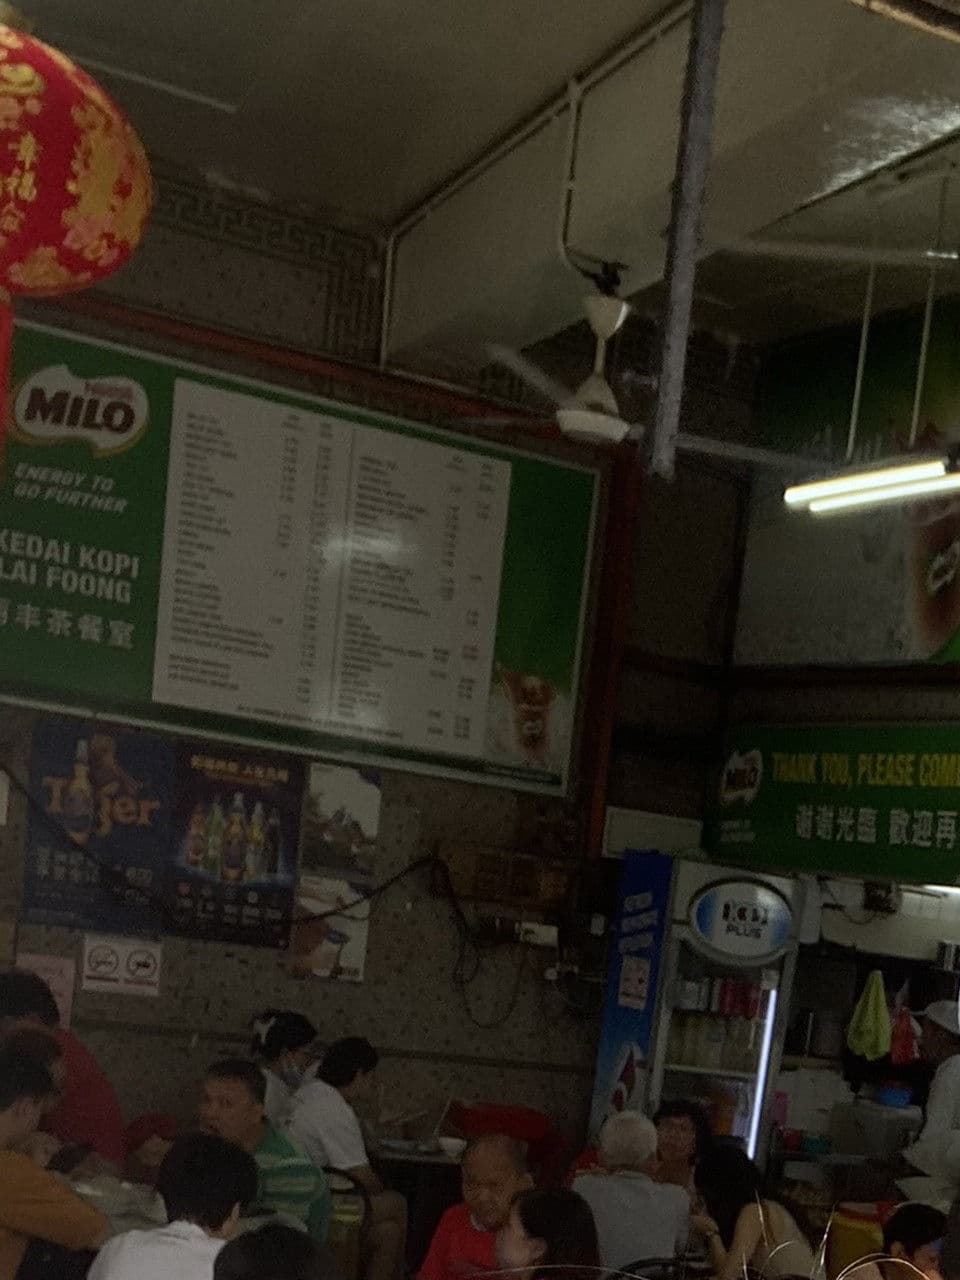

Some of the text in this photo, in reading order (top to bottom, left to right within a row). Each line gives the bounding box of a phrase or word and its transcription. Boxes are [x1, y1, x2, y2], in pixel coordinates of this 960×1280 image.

[25, 387, 135, 433] MILO
[91, 475, 114, 492] TO
[0, 557, 37, 585] LAI
[46, 565, 132, 606] FOONG
[79, 543, 140, 580] KOPI
[772, 751, 817, 784] THANK
[856, 752, 916, 787] PLEASE
[42, 774, 161, 836] Tger
